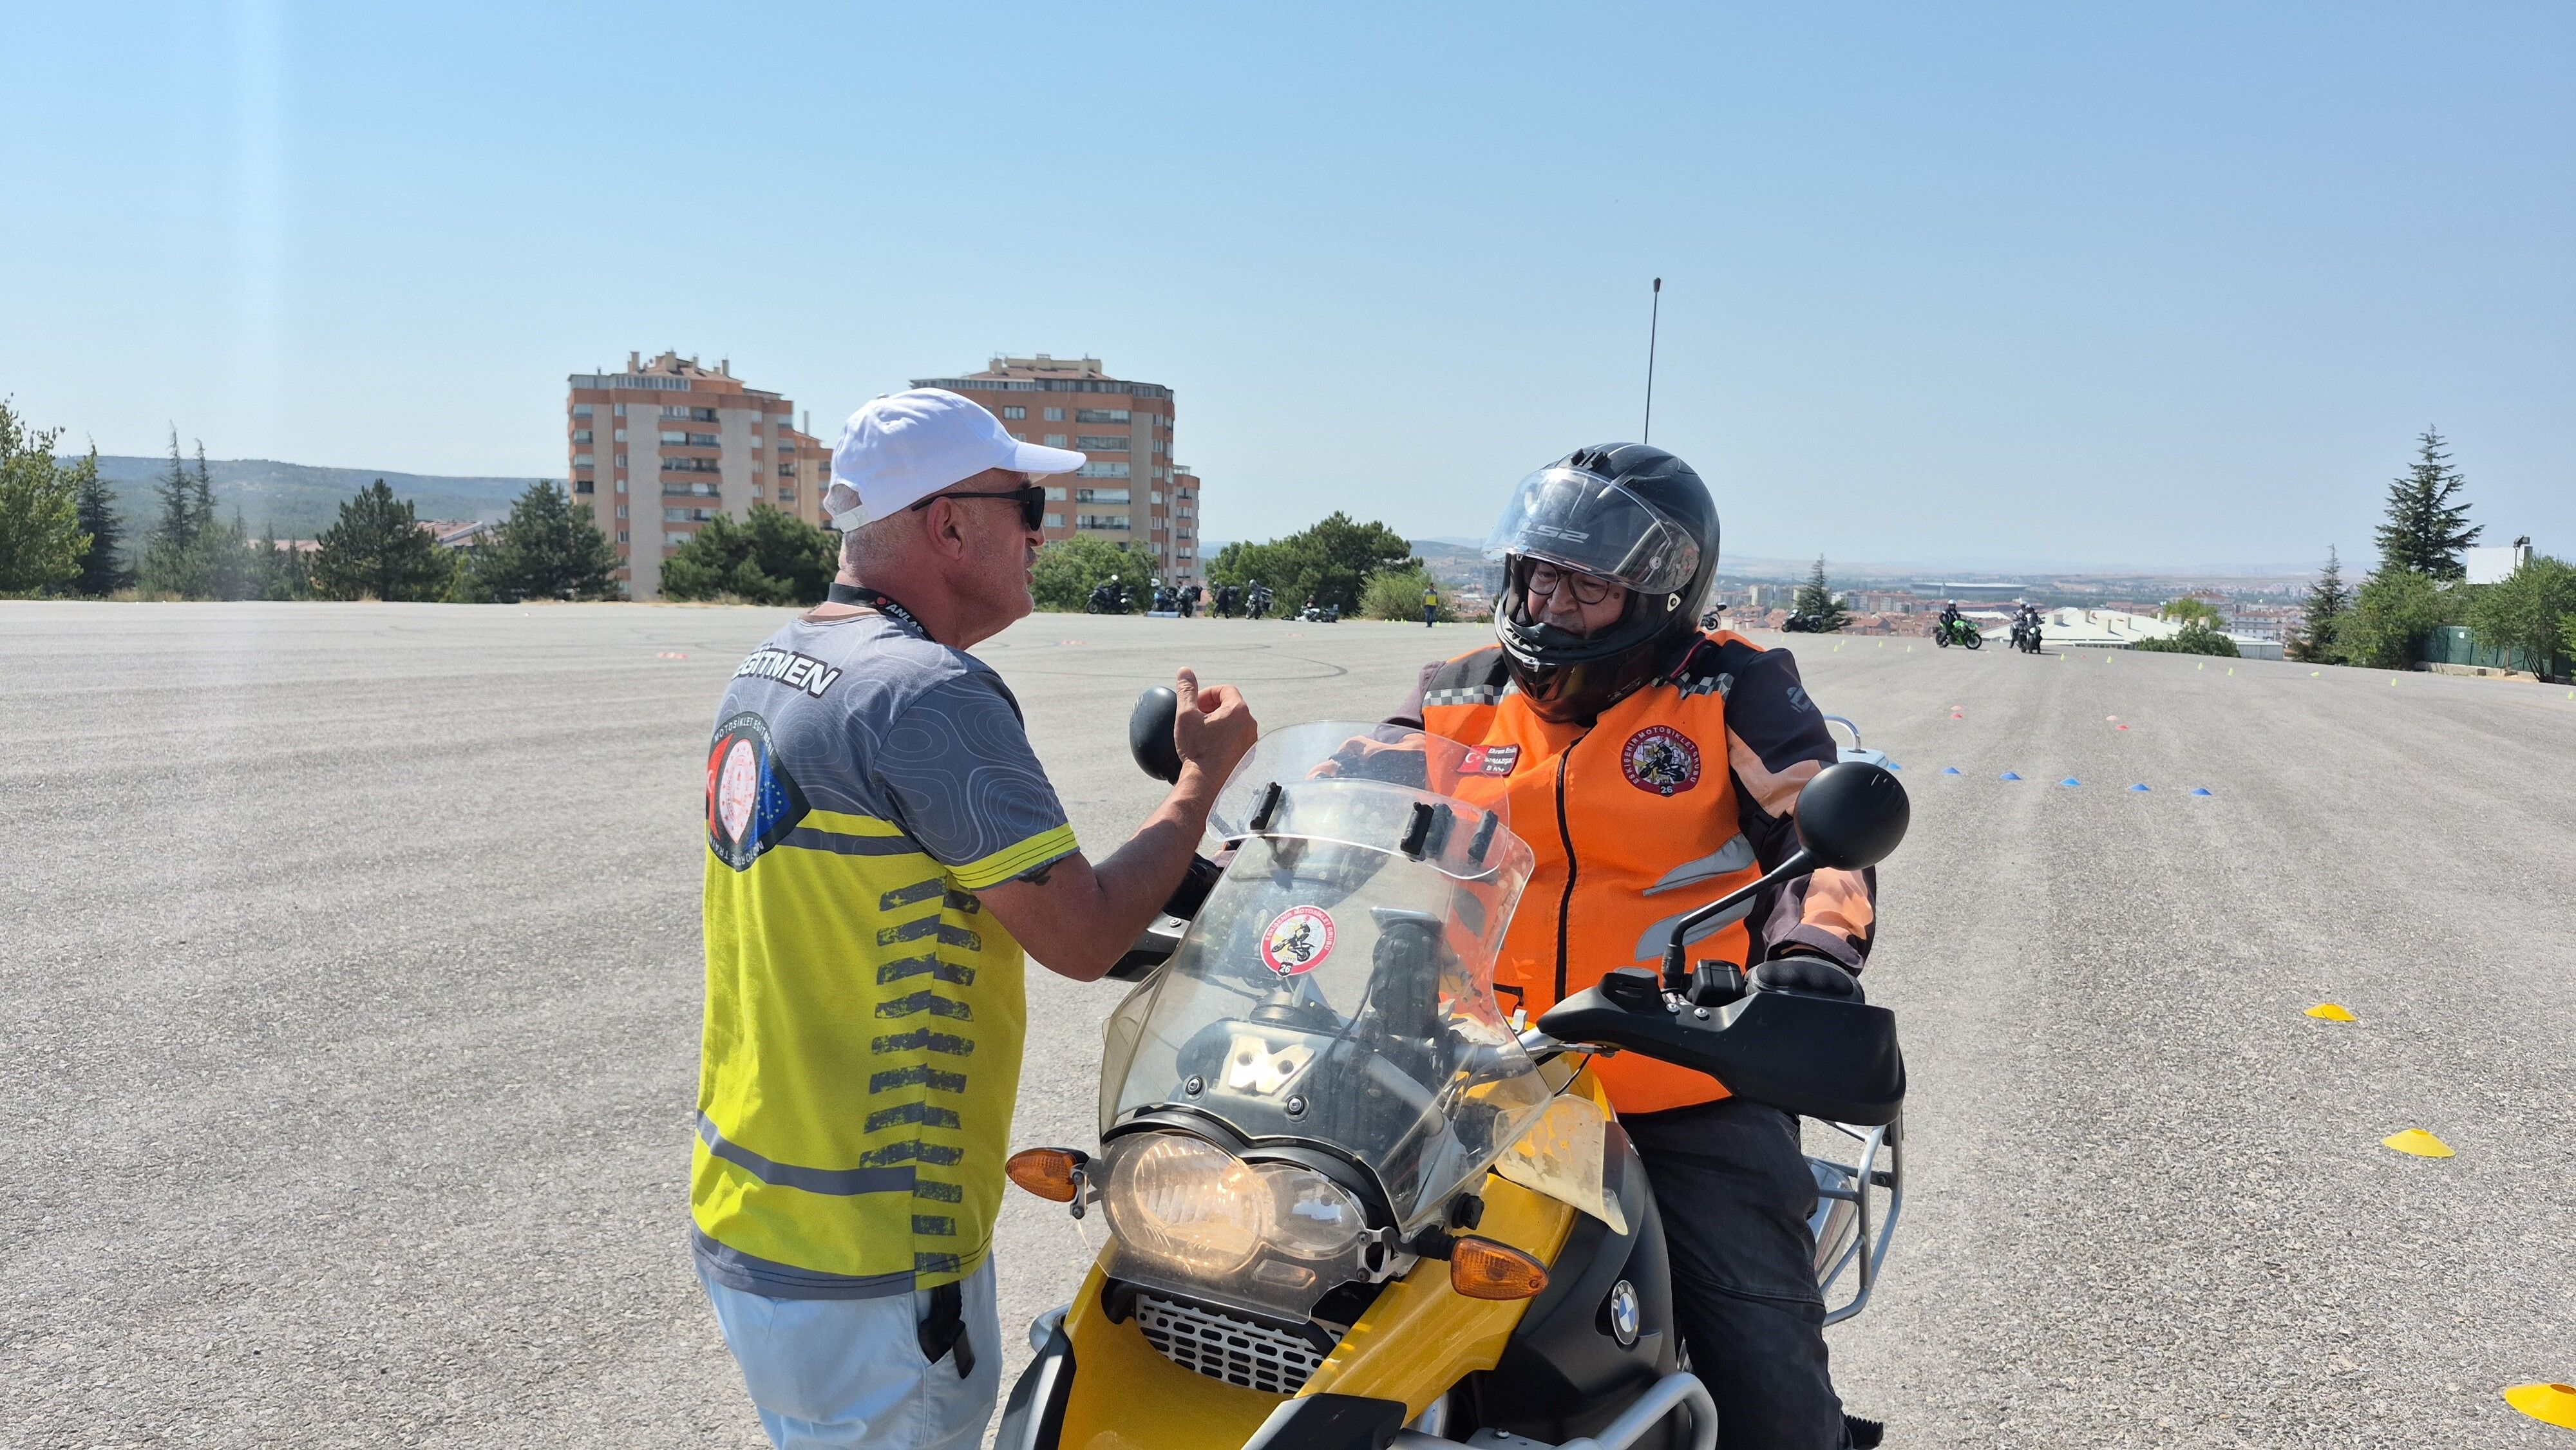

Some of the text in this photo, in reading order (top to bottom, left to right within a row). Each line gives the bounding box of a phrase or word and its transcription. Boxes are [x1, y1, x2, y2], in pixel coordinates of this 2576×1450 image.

[1520, 522, 1590, 543] LS2
[1690, 751, 1700, 783] GRUBU
[1278, 965, 1292, 973] 26
[1613, 1283, 1633, 1310] BMW
